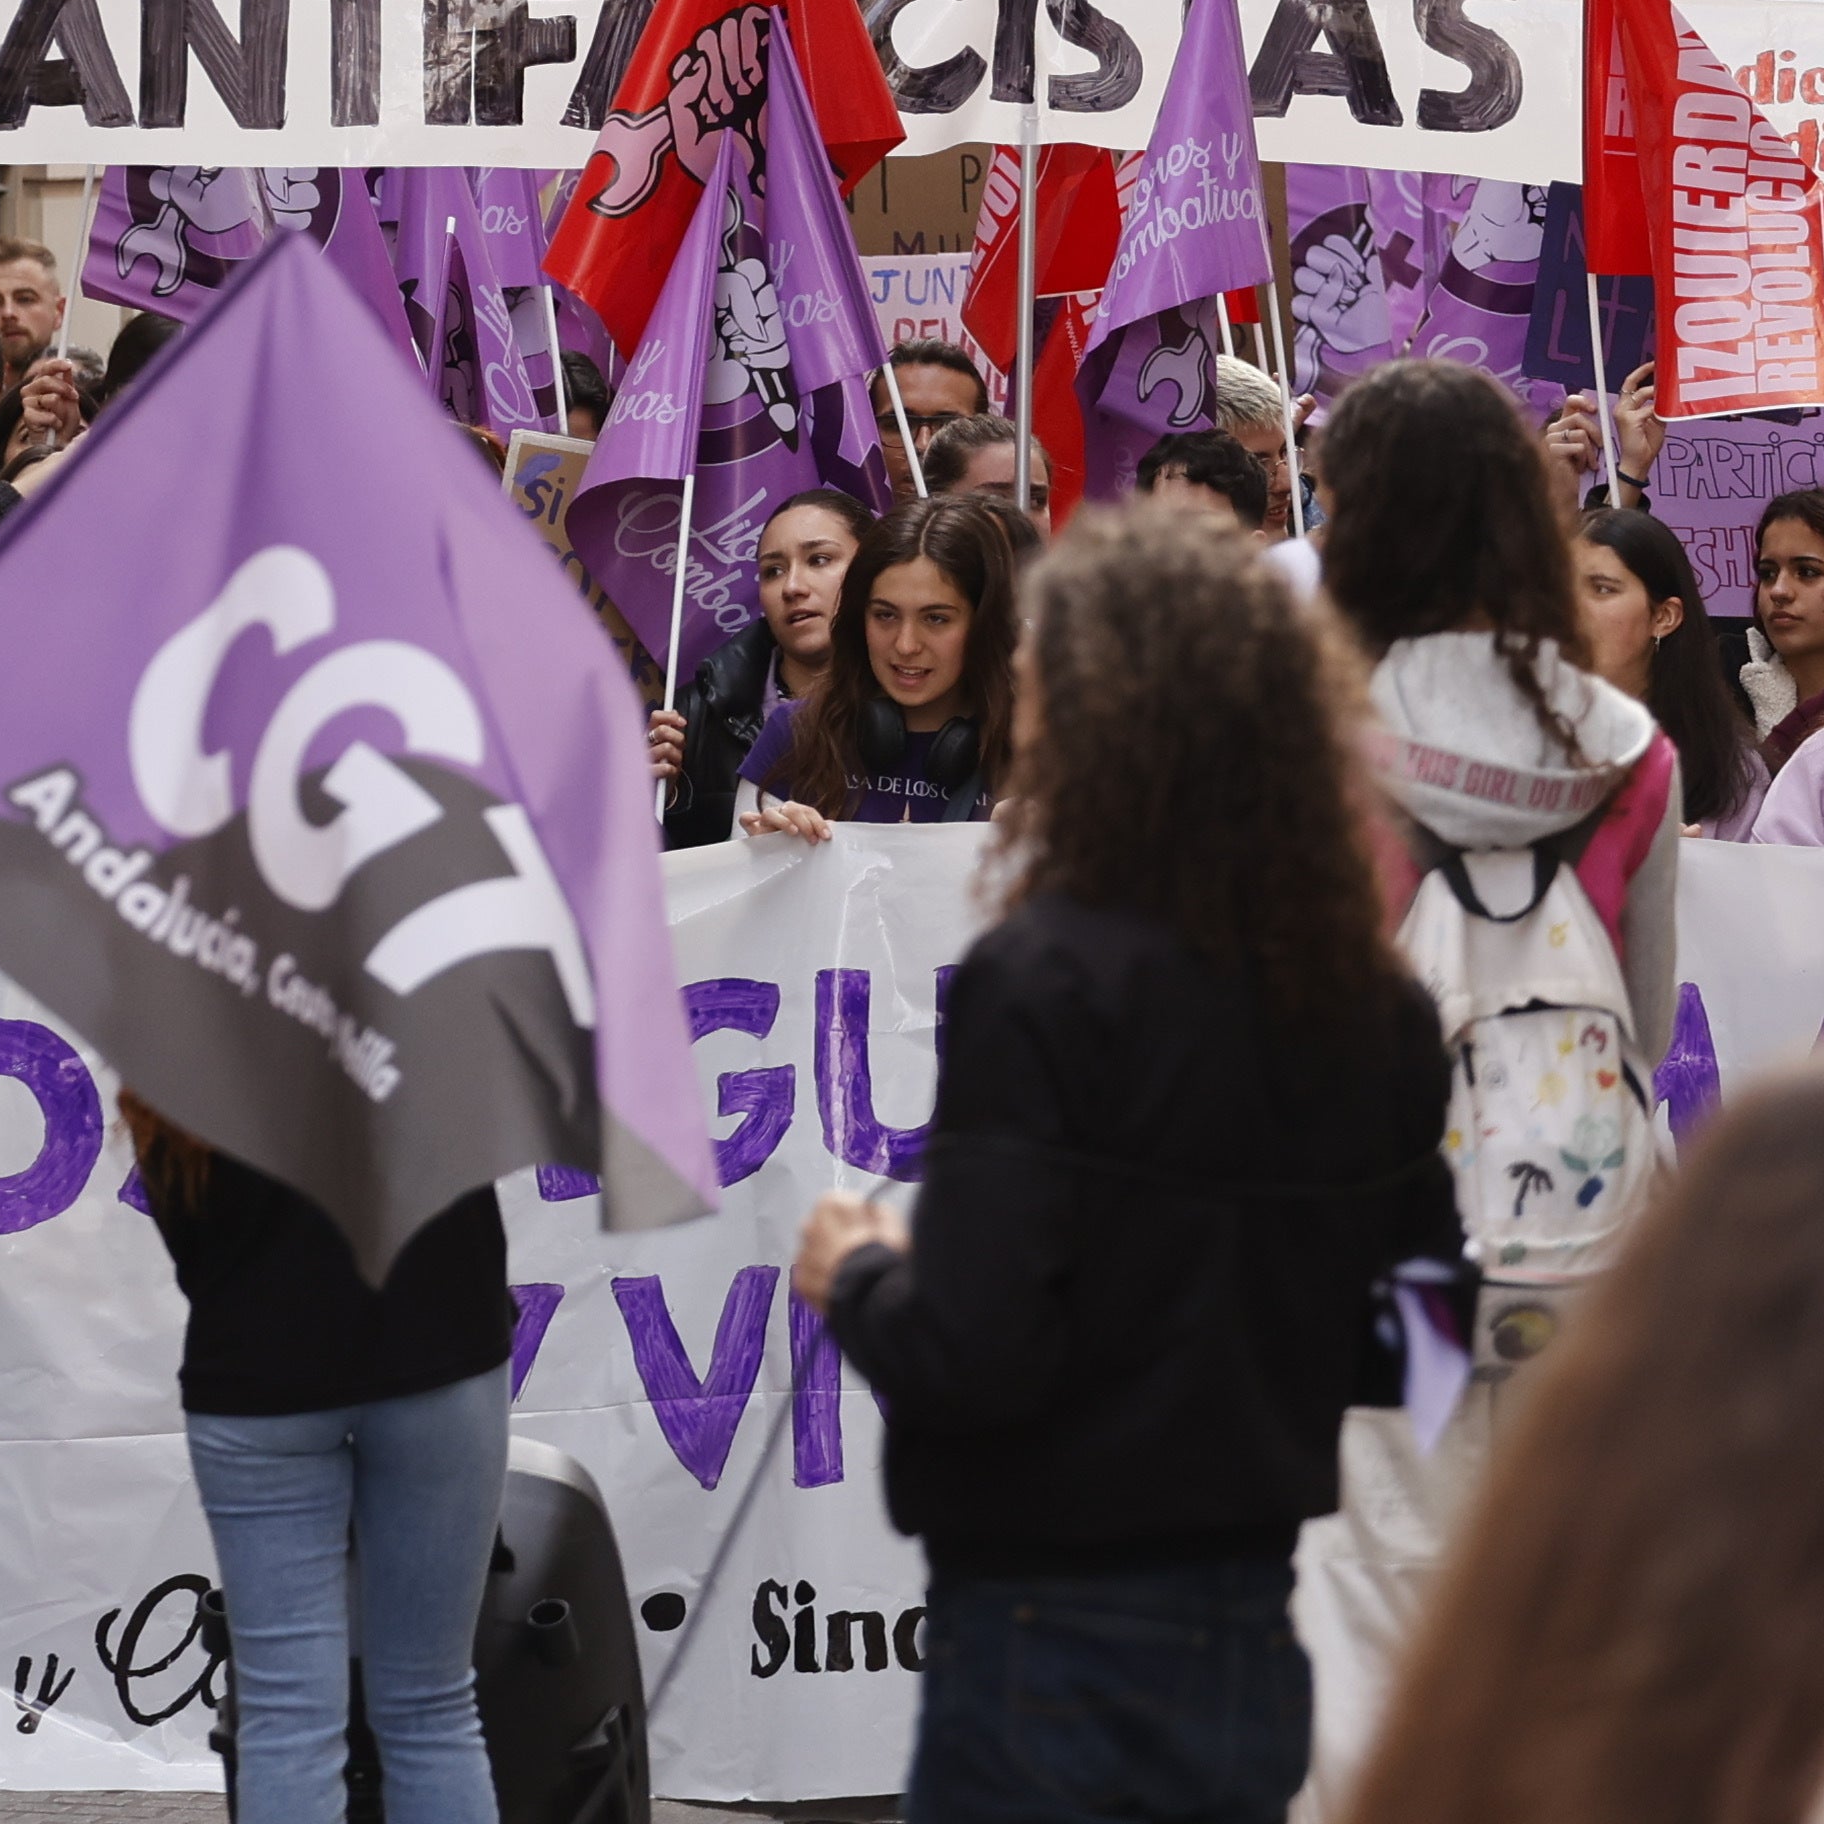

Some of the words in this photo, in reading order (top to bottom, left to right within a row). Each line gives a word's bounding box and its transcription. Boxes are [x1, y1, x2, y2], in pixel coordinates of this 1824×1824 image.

[1220, 132, 1244, 180] y
[129, 544, 599, 1030] CGT
[877, 776, 903, 795] DE
[904, 778, 939, 799] LOS
[1462, 761, 1518, 805] GIRL
[14, 1652, 76, 1735] y
